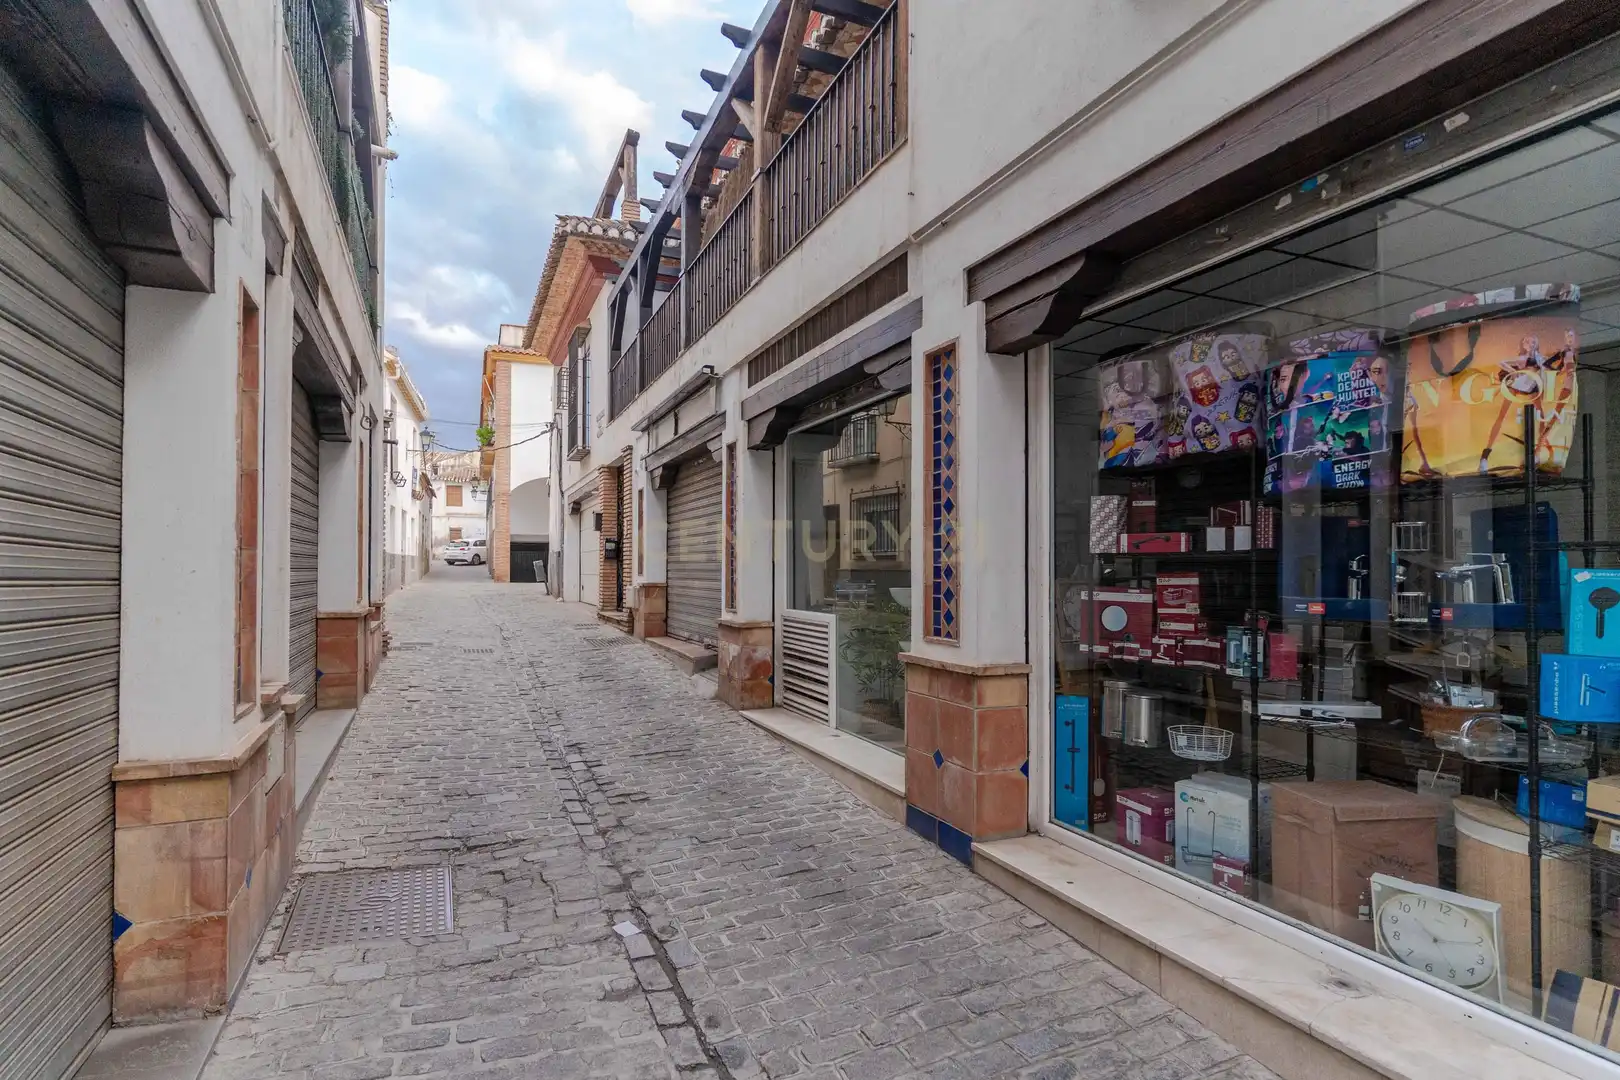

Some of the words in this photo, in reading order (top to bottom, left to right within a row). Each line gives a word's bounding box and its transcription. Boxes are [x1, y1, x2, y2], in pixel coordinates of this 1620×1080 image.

[1337, 371, 1364, 384] KPOP
[1337, 378, 1374, 392] DEMON
[1334, 459, 1373, 474] ENERGY
[1335, 471, 1360, 483] DARK
[1398, 900, 1412, 914] 10
[1416, 897, 1427, 910] 11
[1439, 902, 1452, 917] 12
[1390, 915, 1399, 925] 9
[1463, 918, 1469, 929] 1
[1392, 930, 1401, 941] 8
[1475, 936, 1484, 948] 2
[1406, 948, 1414, 957] 7
[1476, 955, 1485, 966] 3
[1425, 962, 1433, 973] 6
[1466, 967, 1475, 977] 4
[1448, 968, 1456, 979] 5
